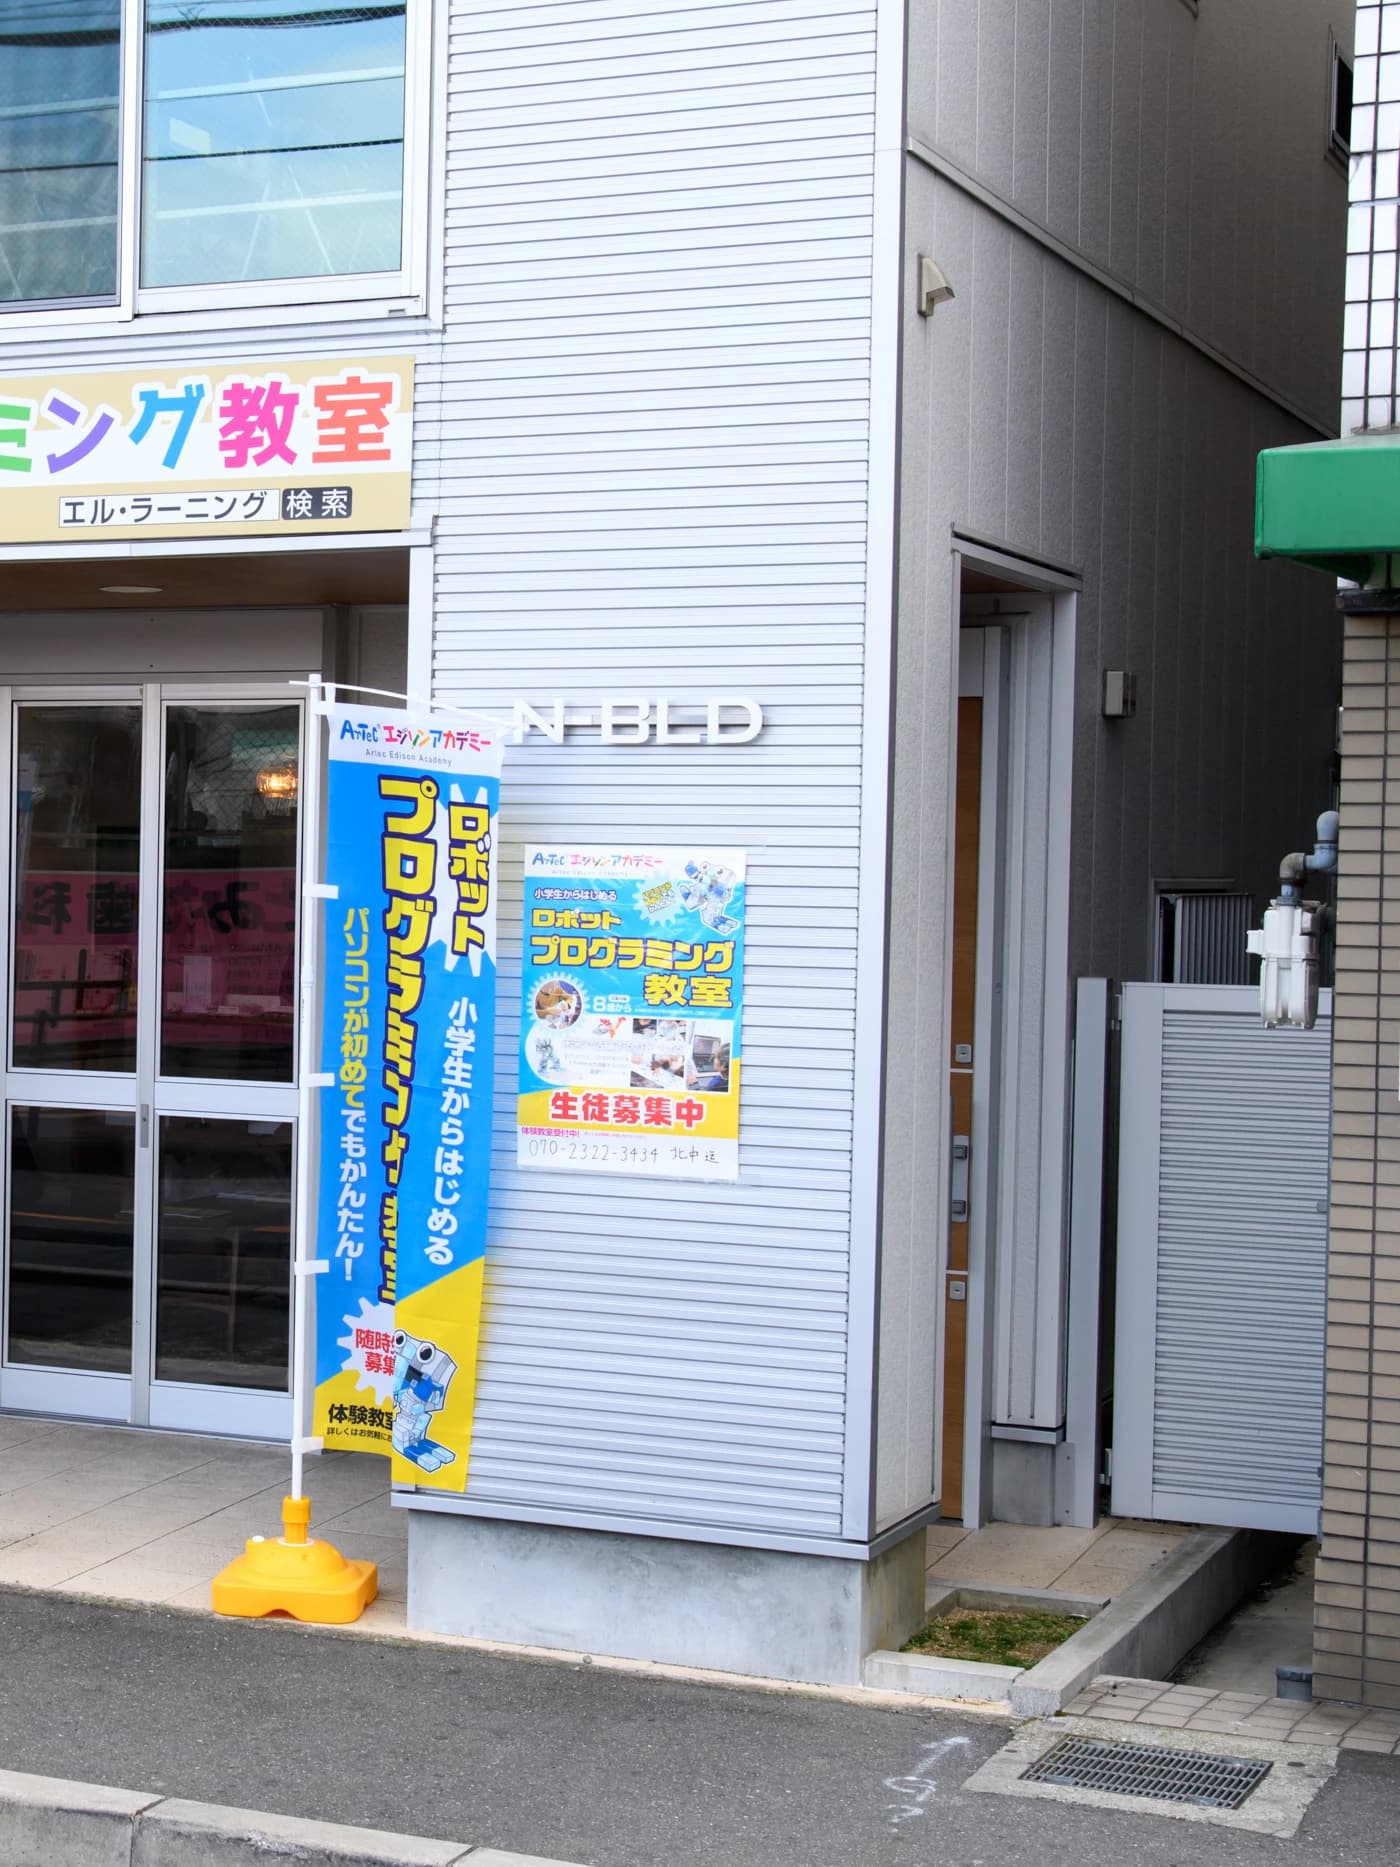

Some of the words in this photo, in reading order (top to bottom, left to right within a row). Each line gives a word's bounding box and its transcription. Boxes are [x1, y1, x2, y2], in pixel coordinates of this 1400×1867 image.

[63, 492, 268, 525] エル・ラーニング
[286, 488, 348, 519] 検索
[383, 725, 492, 752] エジソンアカデミー
[513, 699, 764, 744] N-BLD
[389, 750, 416, 761] Edison
[419, 752, 452, 767] Academy
[448, 801, 491, 956] ロボット
[534, 888, 617, 901] 小学生からはじめる
[531, 908, 622, 930] ロボット
[531, 935, 736, 973] プログラミング
[644, 973, 733, 1009] 教室
[551, 1091, 704, 1128] 生徒募集中
[424, 997, 478, 1266] 小学生からはじめる
